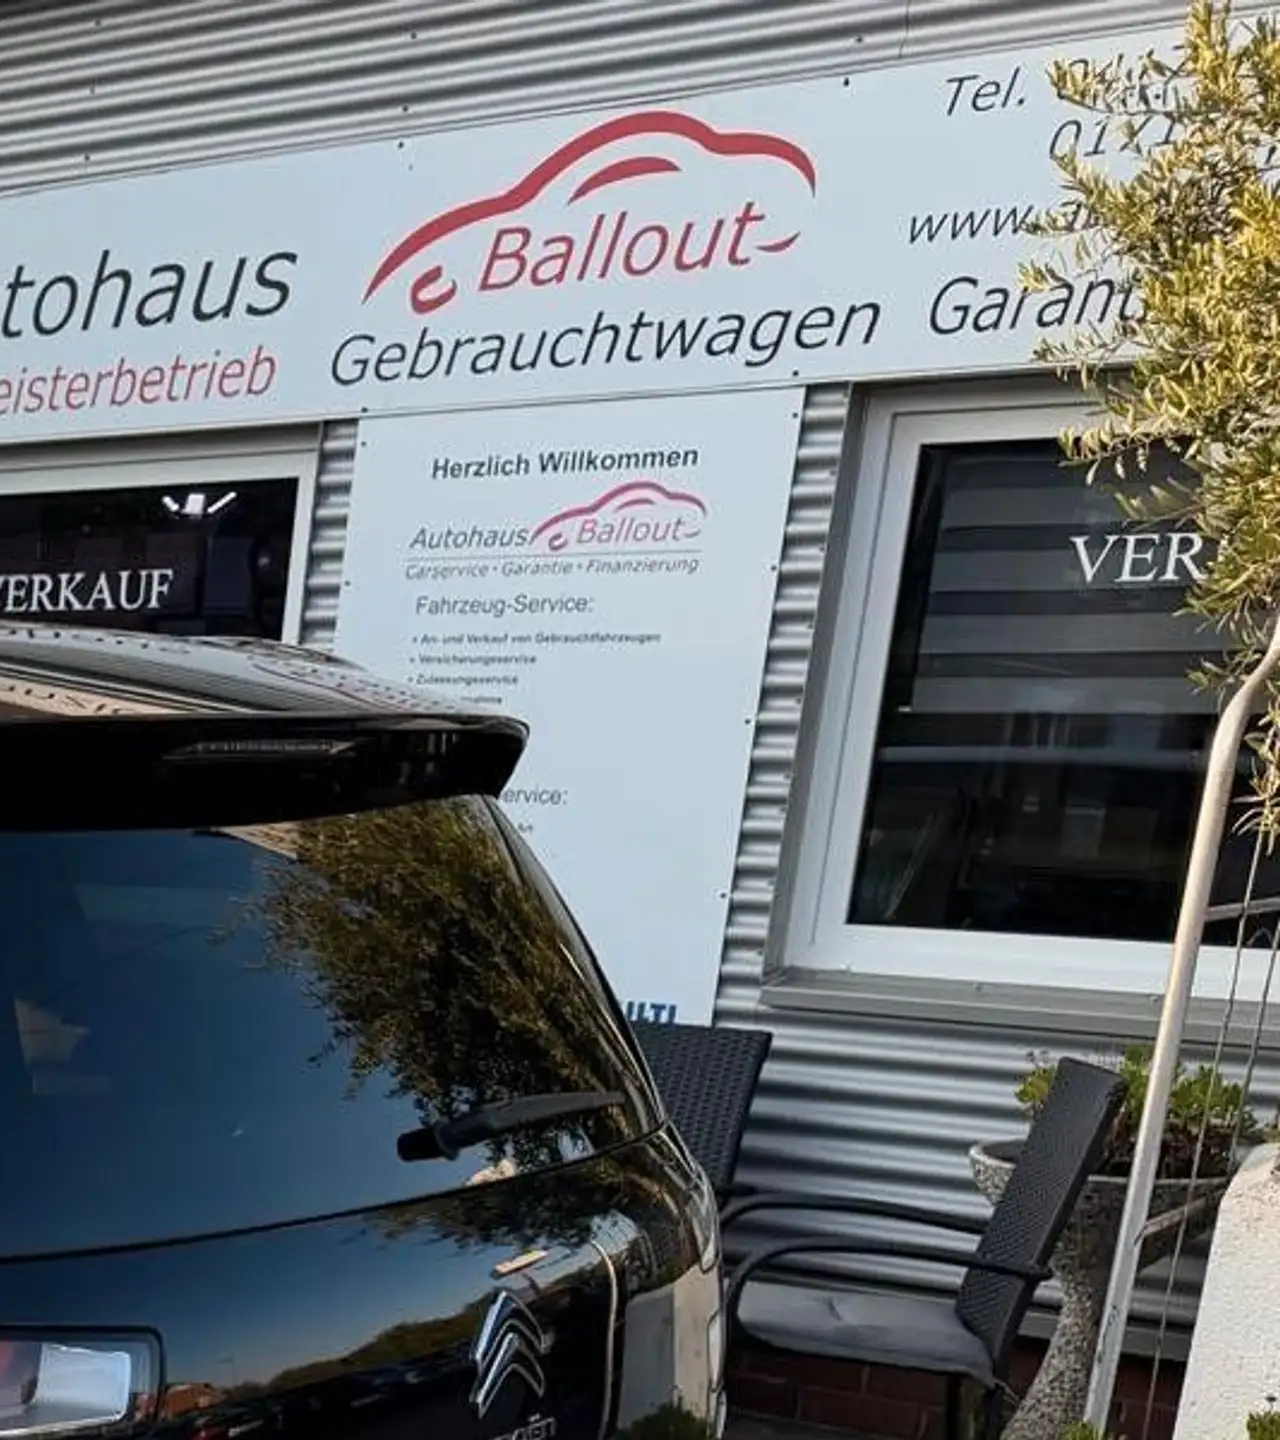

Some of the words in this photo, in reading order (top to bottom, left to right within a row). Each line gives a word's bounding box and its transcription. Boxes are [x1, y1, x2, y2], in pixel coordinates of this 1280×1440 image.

[945, 66, 1025, 116] Tel.
[478, 201, 765, 292] Ballout
[331, 300, 882, 387] Gebrauchtwagen
[432, 454, 530, 479] Herzlich
[539, 449, 698, 473] Willkommen
[409, 526, 528, 549] Autohaus
[576, 518, 685, 544] Ballout
[405, 561, 489, 580] Carservice
[500, 560, 572, 577] Garantie
[586, 557, 699, 576] Finanzierung
[1069, 532, 1209, 584] VER
[416, 593, 595, 618] Fahrzeug-Service:
[503, 786, 568, 806] ervice:
